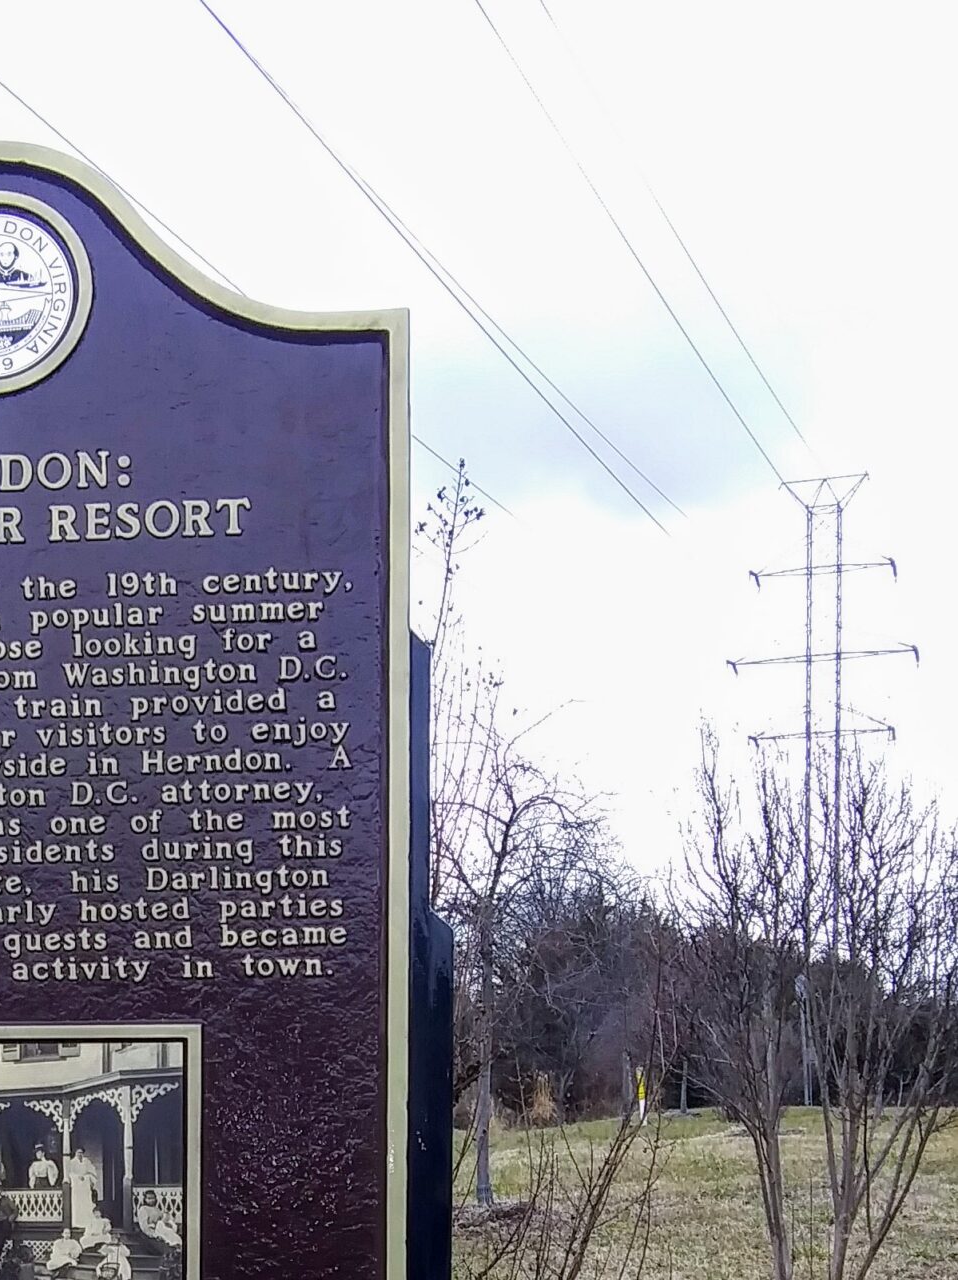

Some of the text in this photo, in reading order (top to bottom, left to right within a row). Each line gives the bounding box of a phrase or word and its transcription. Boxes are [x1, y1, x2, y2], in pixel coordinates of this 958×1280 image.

[26, 256, 67, 355] VIRGINIA
[48, 497, 251, 541] RESORT
[21, 576, 76, 599] the
[107, 572, 177, 596] 19th
[202, 566, 352, 593] century,
[30, 602, 163, 634] popular
[192, 601, 323, 622] summer
[73, 631, 196, 659] looking
[222, 628, 272, 651] for
[298, 630, 316, 649] a
[62, 658, 256, 687] Washington
[279, 655, 347, 680] D.C.
[14, 693, 102, 718] train
[130, 687, 286, 721] provided
[318, 691, 336, 709] a
[36, 721, 165, 746] visitors
[192, 719, 227, 742] to
[251, 716, 350, 746] enjoy
[87, 751, 119, 775] in
[141, 747, 291, 773] Herndon.
[328, 744, 352, 768] A
[71, 781, 138, 805] D.C.
[161, 779, 322, 804] attorney,
[50, 815, 106, 834] one
[130, 809, 162, 833] of
[189, 808, 243, 831] the
[272, 805, 350, 829] most
[141, 835, 253, 864] during
[278, 833, 342, 857] this
[70, 868, 119, 892] his
[146, 864, 329, 894] Darlington
[80, 896, 190, 922] hosted
[218, 893, 343, 924] parties
[3, 927, 109, 957] guests
[134, 925, 193, 949] and
[219, 924, 347, 947] became
[12, 955, 150, 982] activity
[182, 954, 214, 978] in
[241, 953, 333, 976] town.
